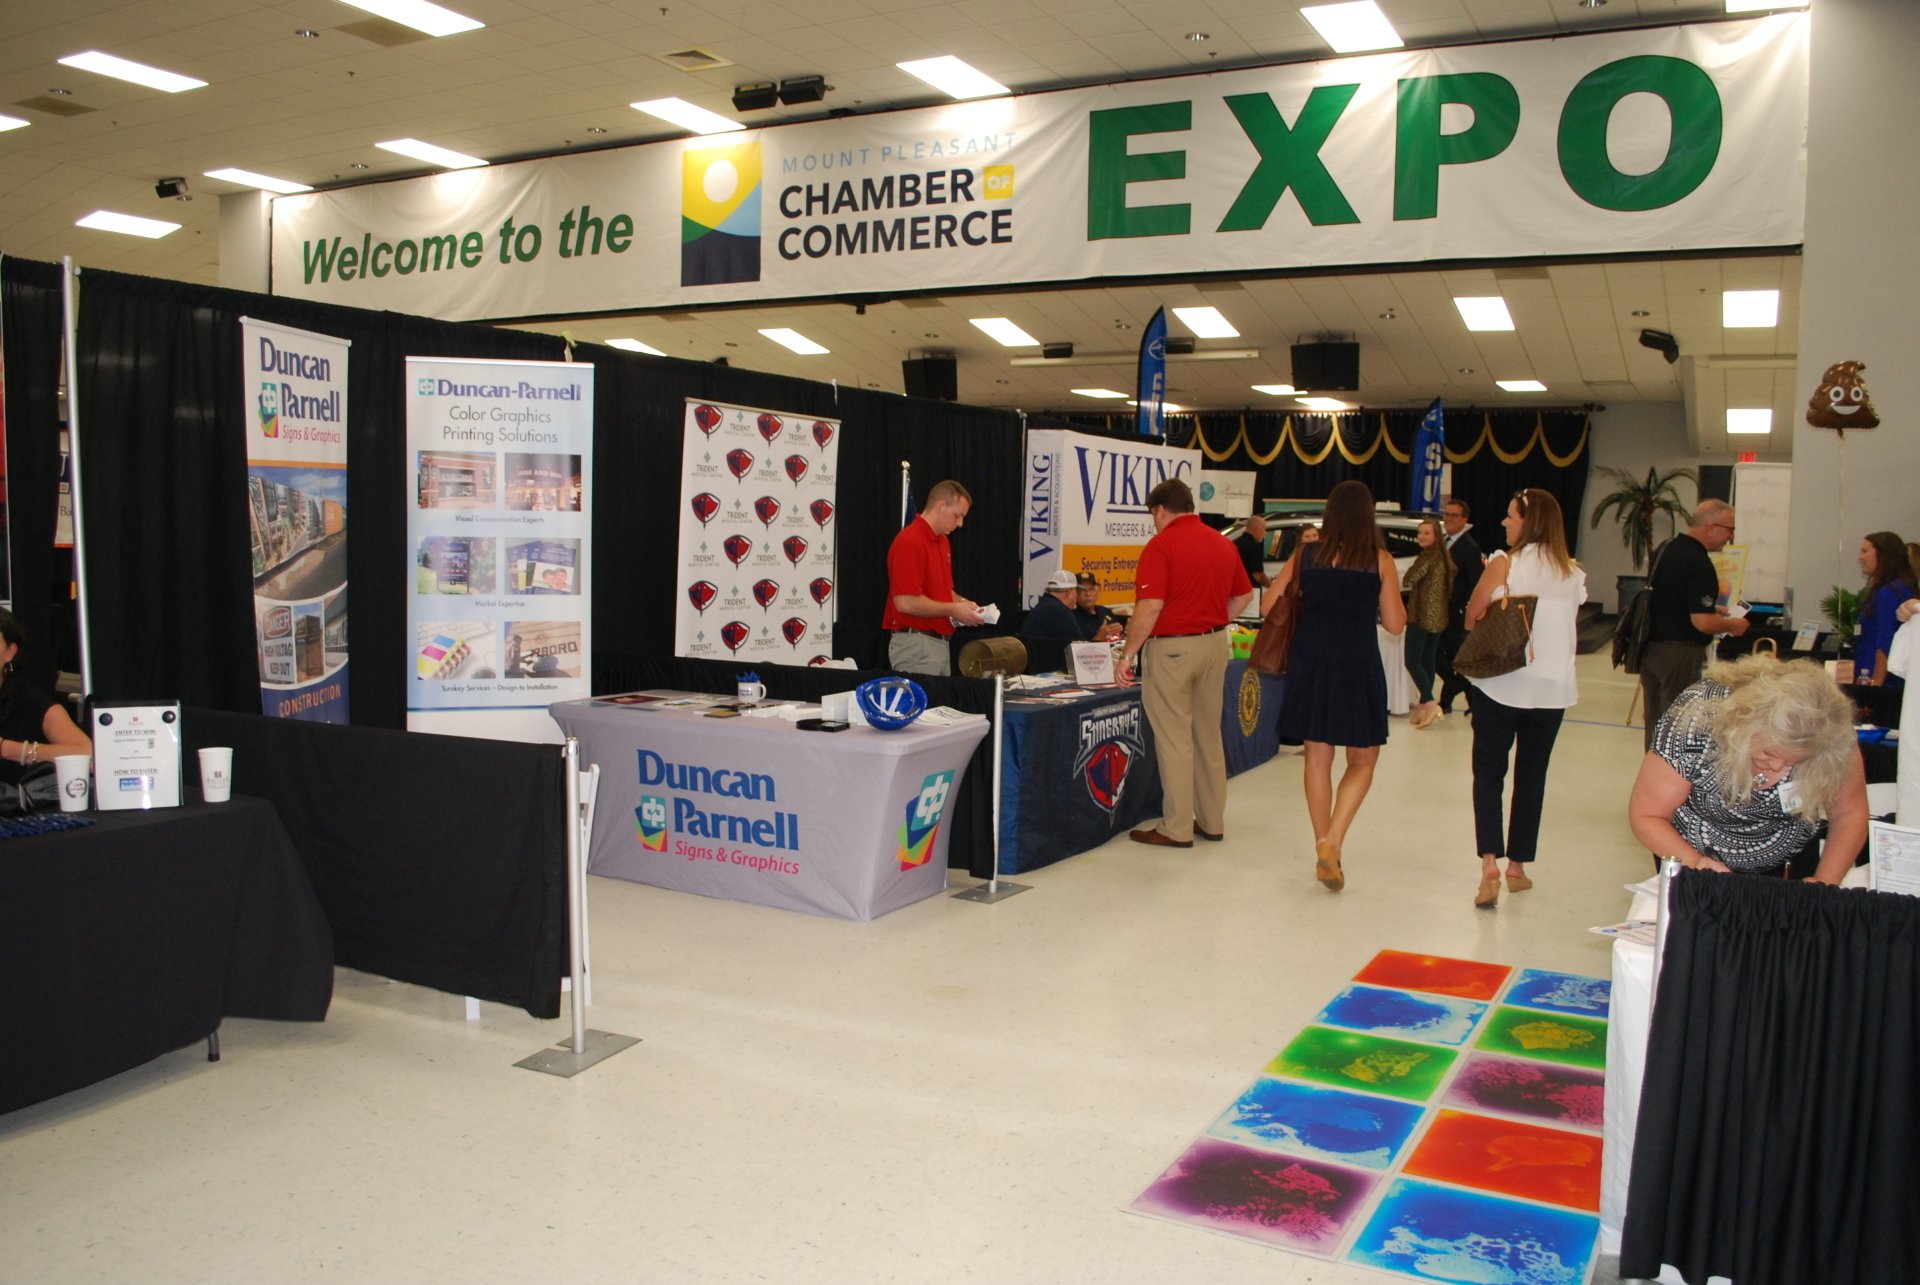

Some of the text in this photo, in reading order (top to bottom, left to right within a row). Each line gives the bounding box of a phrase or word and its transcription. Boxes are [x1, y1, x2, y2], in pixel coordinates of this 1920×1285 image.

[782, 132, 1017, 174] MOUNT PLEASANT
[1087, 54, 1723, 241] EXPO
[779, 168, 1011, 219] CHAMBER OF
[303, 205, 634, 284] Welcome to the
[778, 208, 1013, 261] COMMERCE
[259, 336, 331, 382] Duncan
[281, 382, 340, 423] Parnell
[438, 379, 581, 401] Duncan-Parnell
[449, 404, 552, 428] Color Graphics
[283, 425, 341, 444] Signs & Graphics
[443, 426, 558, 445] Printing Solutions
[455, 515, 474, 523] Visual
[1030, 455, 1054, 562] VIKING
[1105, 523, 1139, 537] MERGERS
[1141, 525, 1145, 536] &
[1081, 557, 1112, 573] Securing
[498, 600, 525, 609] Expertise
[278, 684, 342, 718] CONSTRUCTION
[442, 685, 465, 694] Turnkey
[497, 684, 518, 693] Design
[637, 748, 776, 802] Duncan
[674, 797, 800, 851] Parnell
[675, 840, 800, 875] Signs & Graphics
